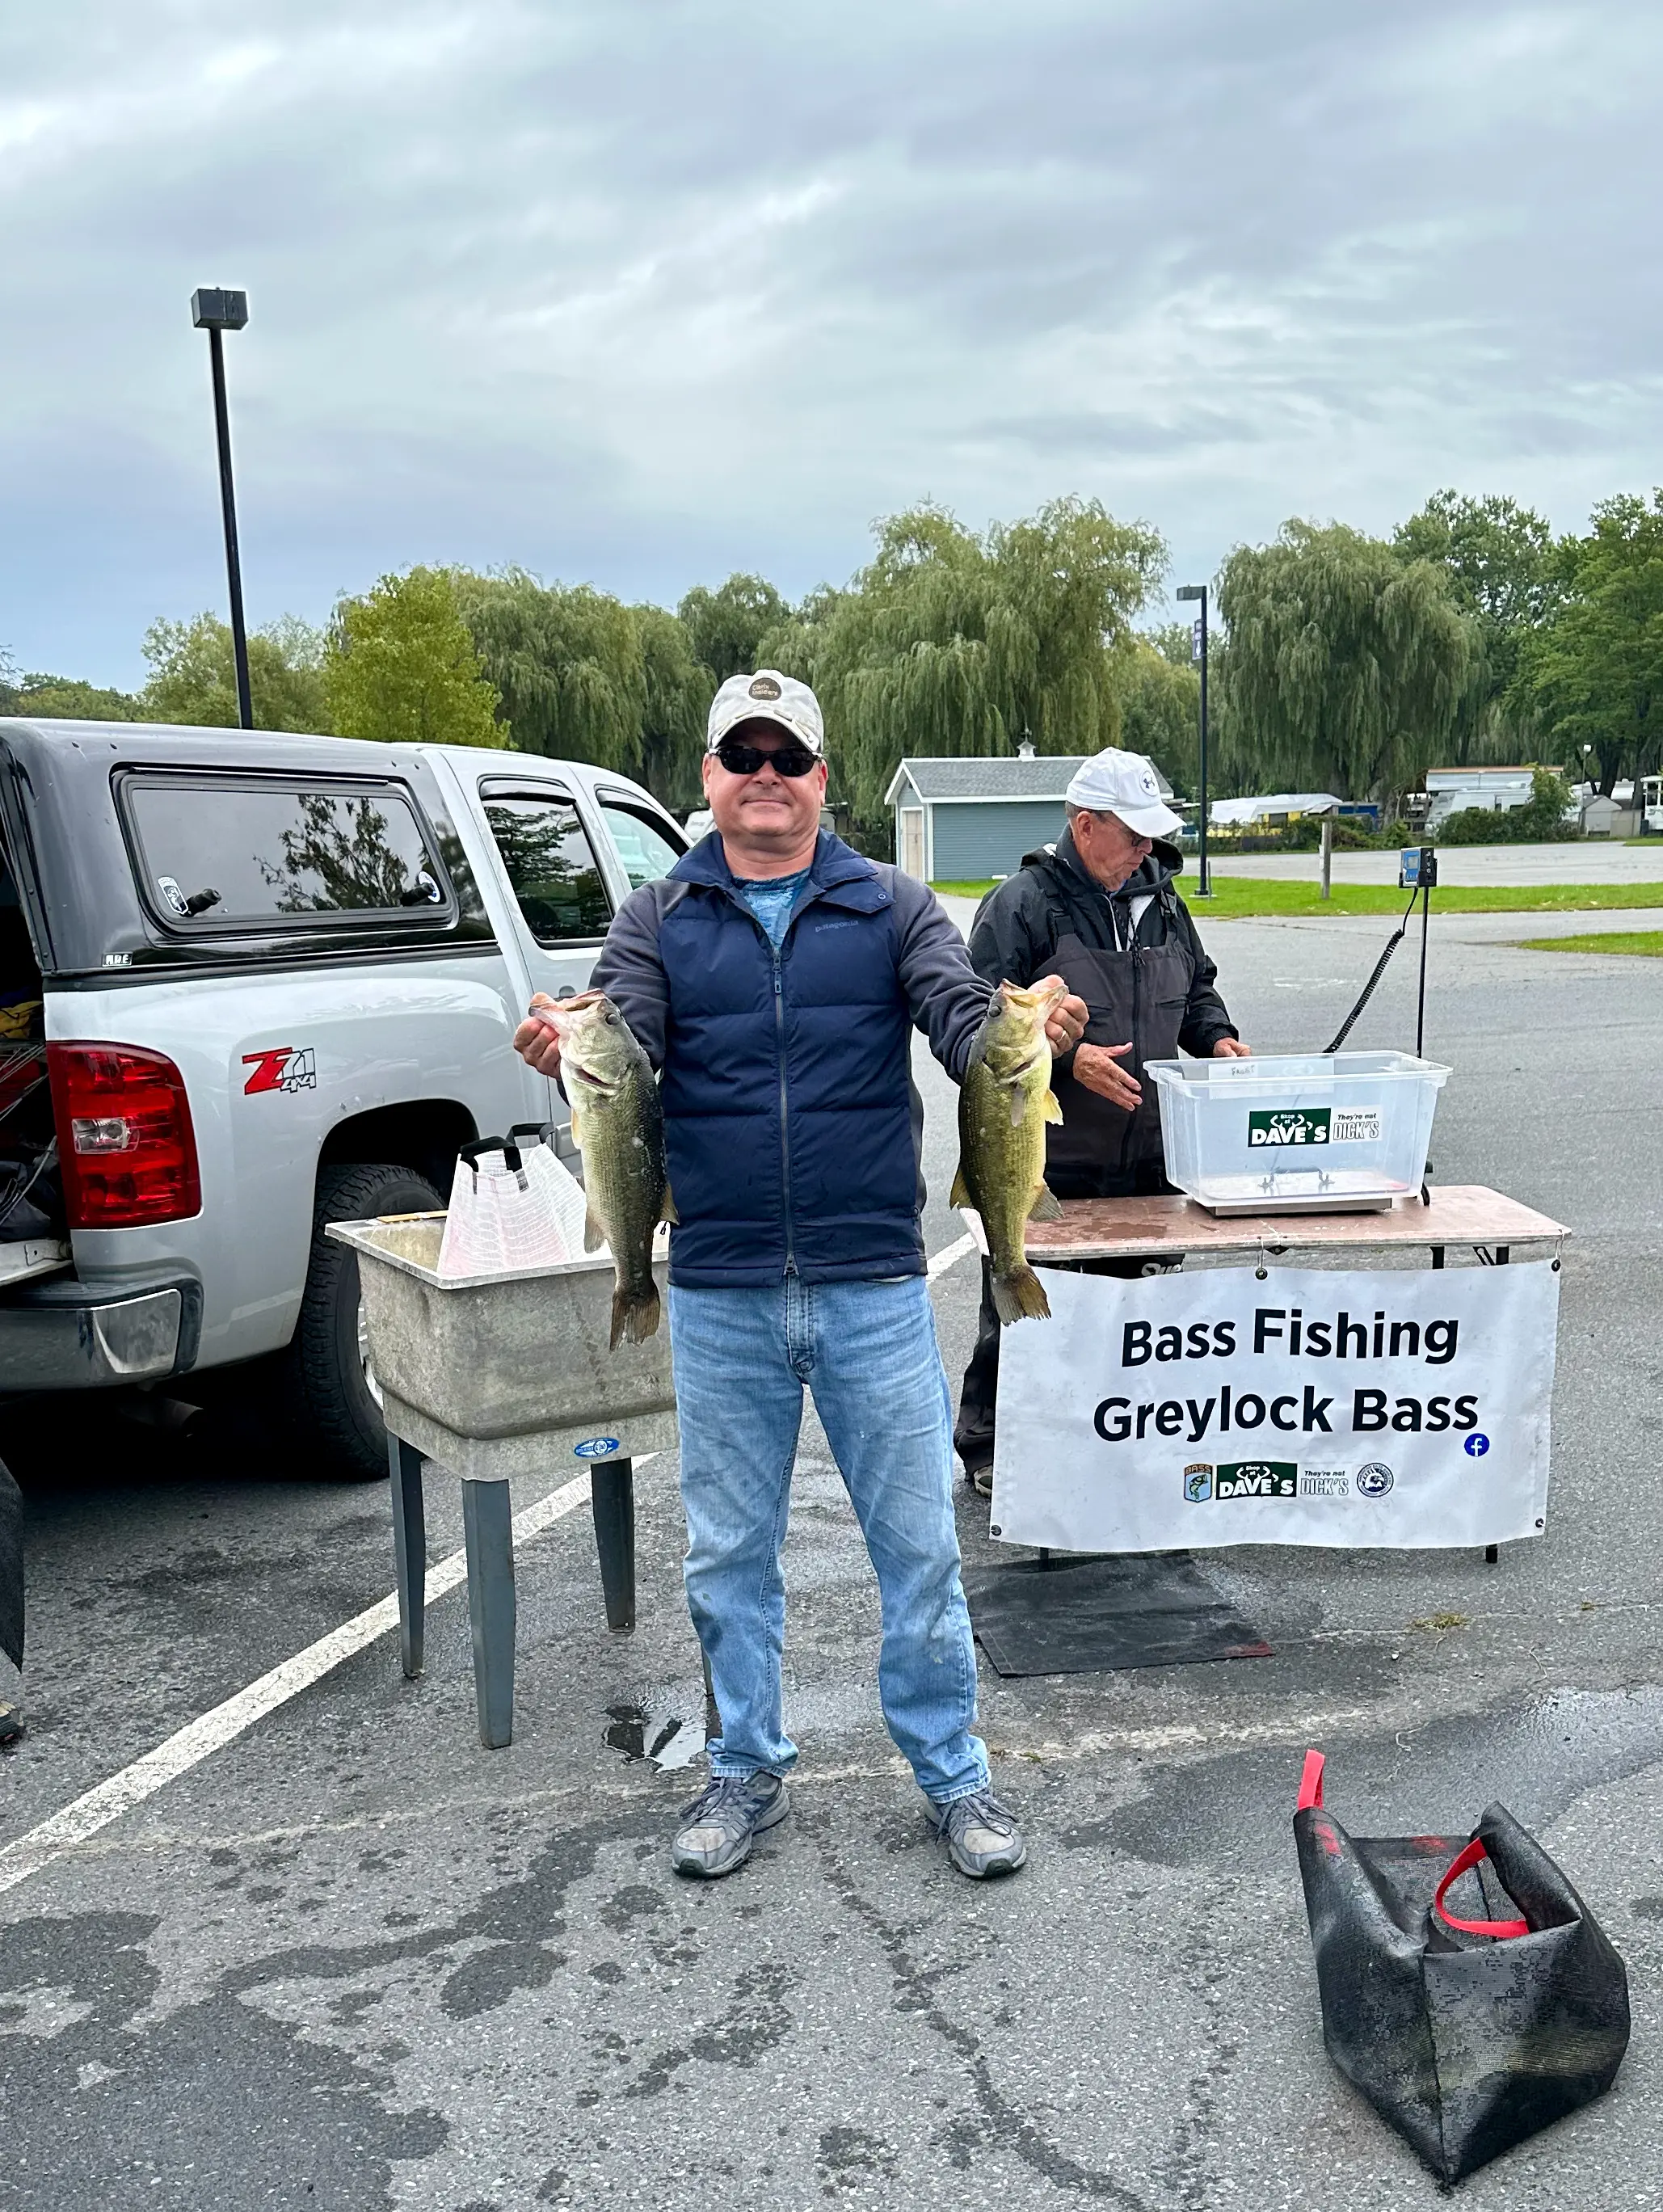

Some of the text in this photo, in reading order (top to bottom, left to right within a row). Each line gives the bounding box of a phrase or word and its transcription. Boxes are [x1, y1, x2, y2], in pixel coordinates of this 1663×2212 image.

[1251, 1121, 1327, 1145] DAVE'S
[1333, 1121, 1379, 1140] DICK'S
[1122, 1308, 1459, 1367] Bass Fishing
[1093, 1384, 1479, 1442] Greylock Bass
[1185, 1464, 1211, 1475] BASS
[1219, 1473, 1294, 1498] DAVE'S
[1300, 1477, 1349, 1496] DICK'S
